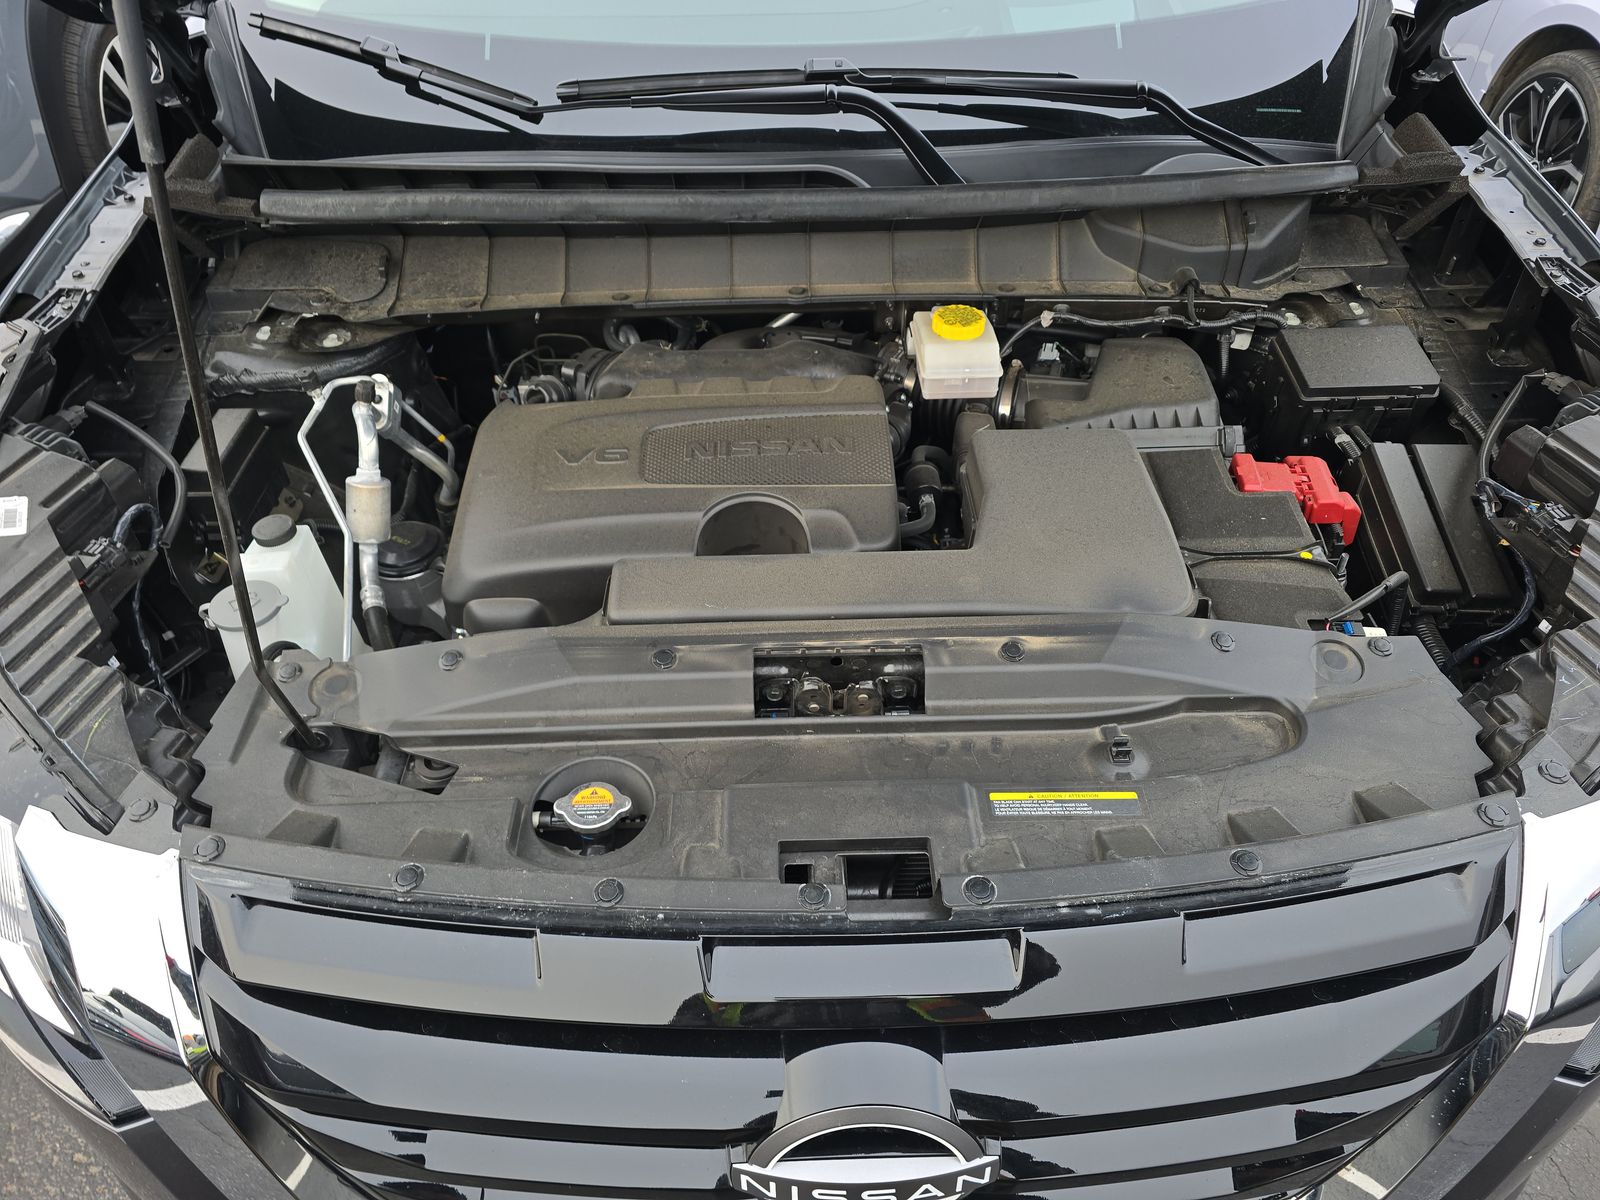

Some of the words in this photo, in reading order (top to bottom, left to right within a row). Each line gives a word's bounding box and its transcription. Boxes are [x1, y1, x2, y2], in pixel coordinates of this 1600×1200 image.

[553, 447, 630, 466] V6
[683, 437, 851, 461] NISSAN
[740, 1166, 991, 1200] NISSAN
